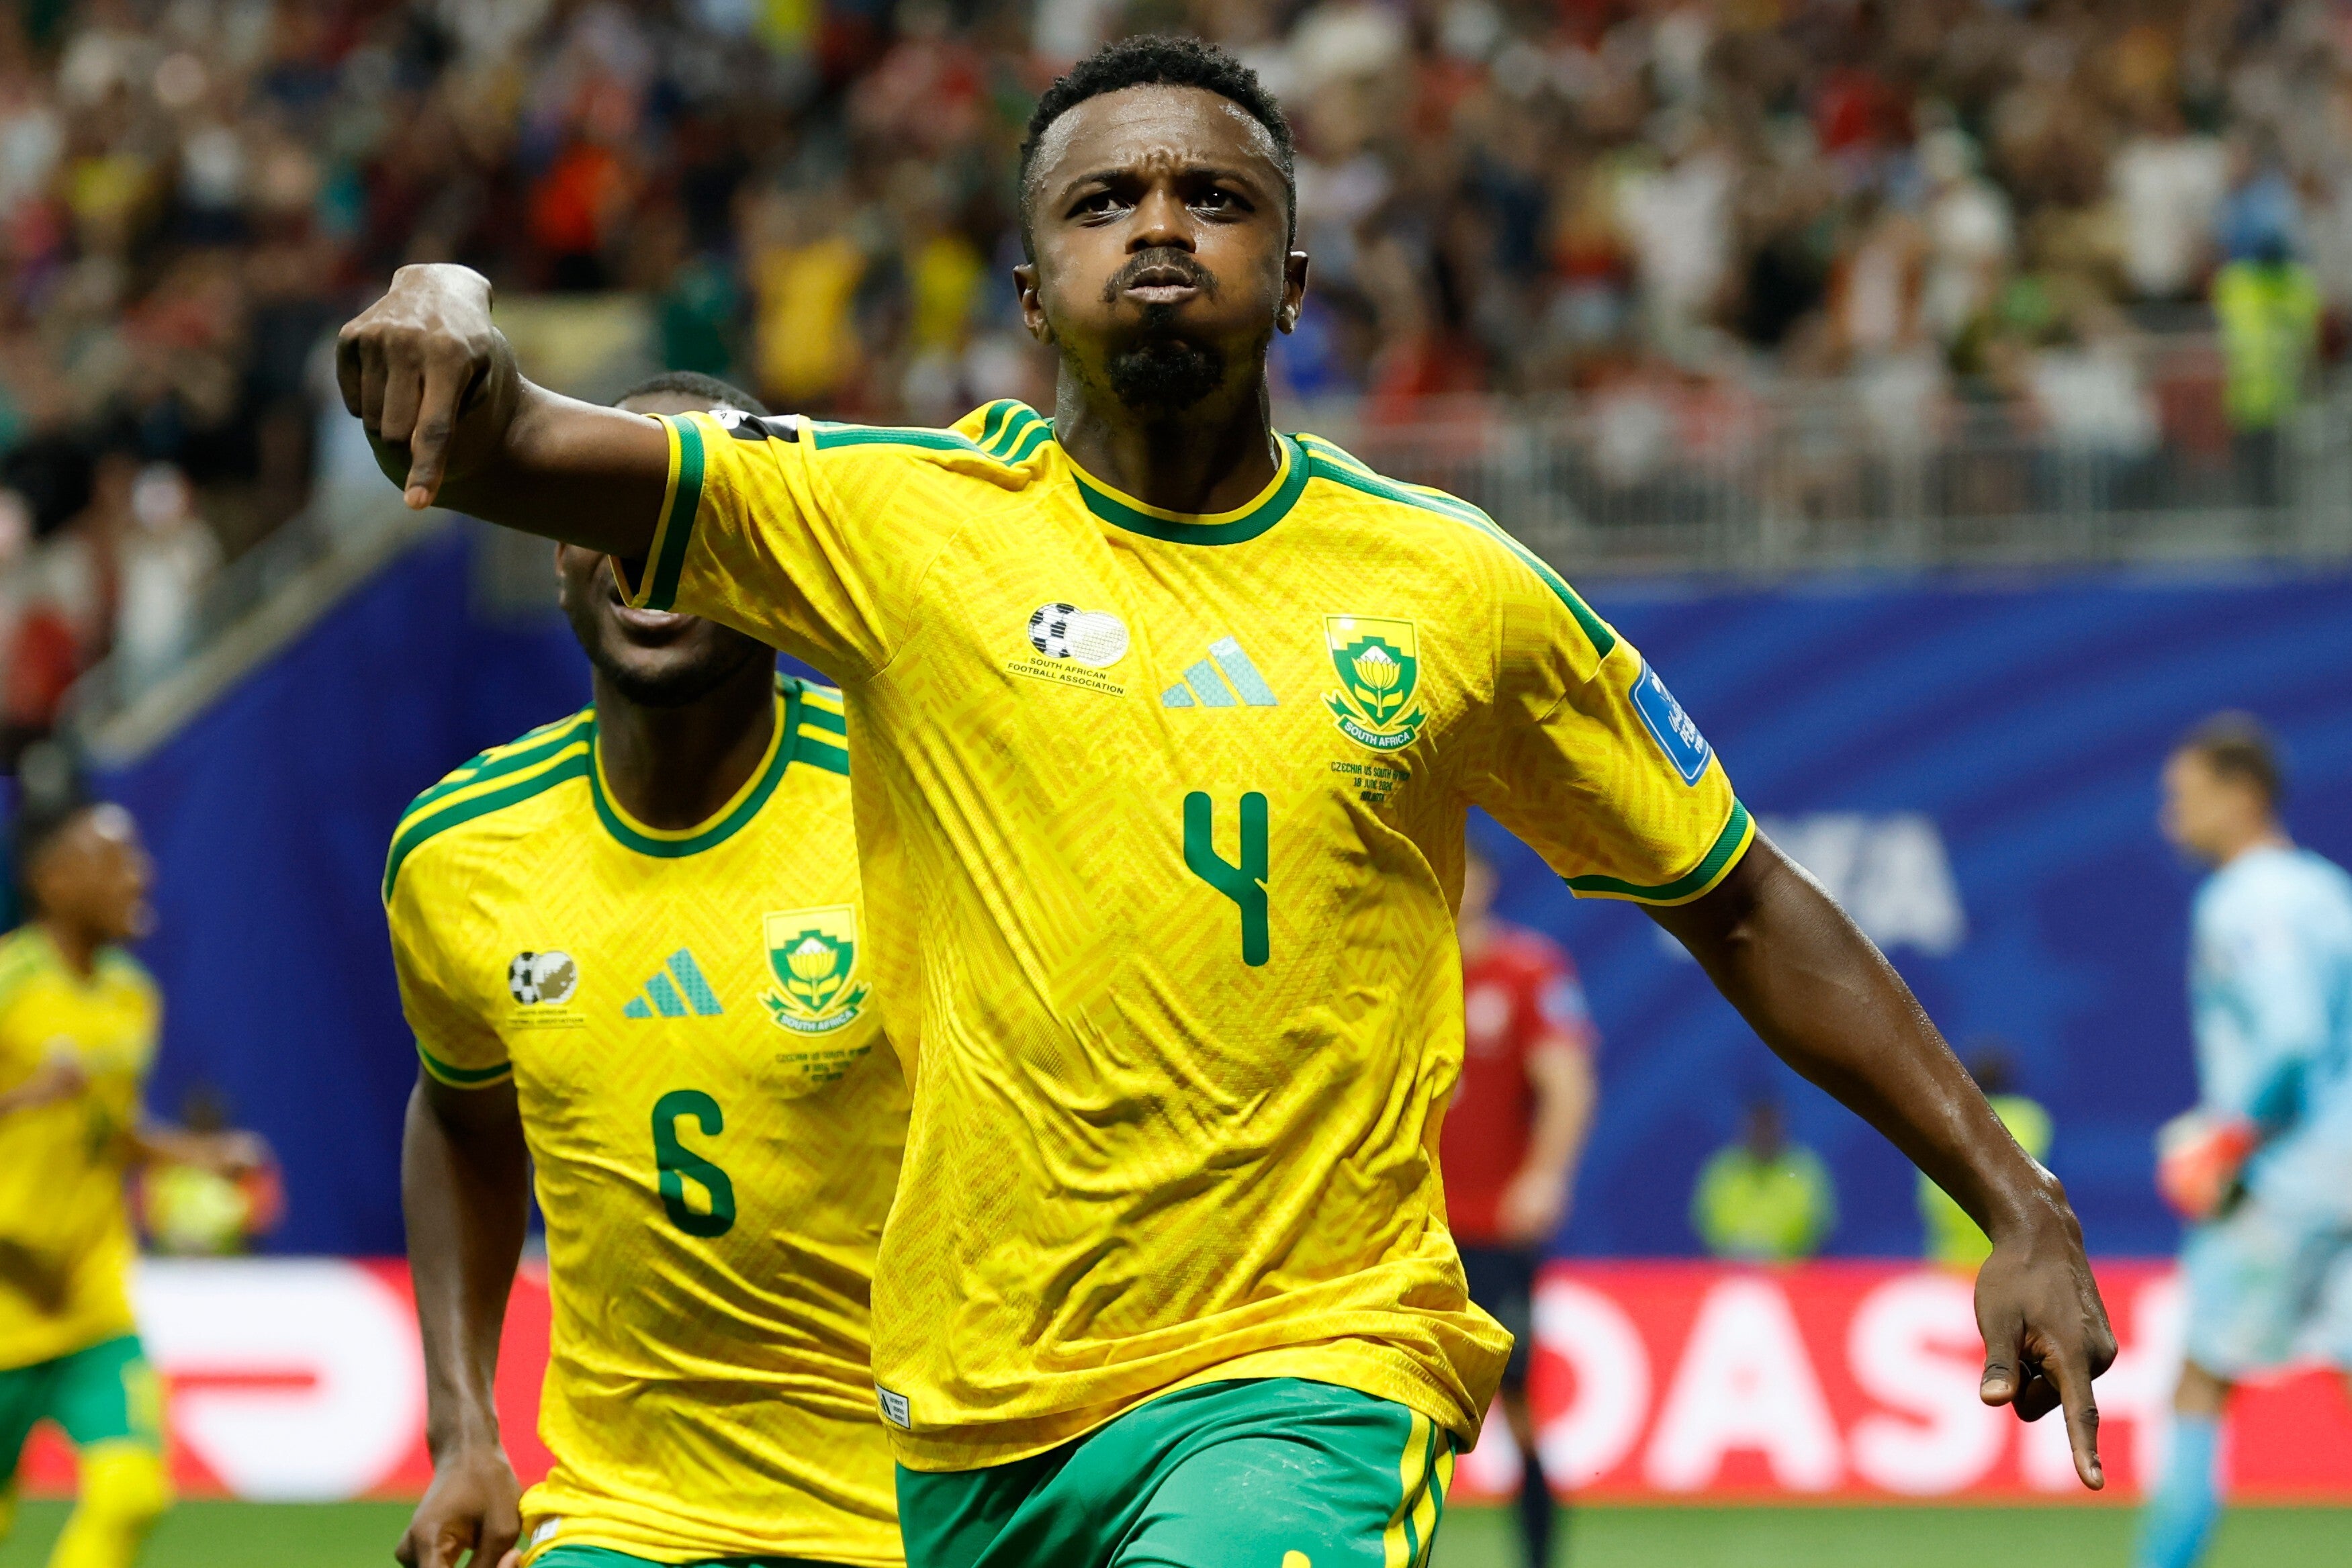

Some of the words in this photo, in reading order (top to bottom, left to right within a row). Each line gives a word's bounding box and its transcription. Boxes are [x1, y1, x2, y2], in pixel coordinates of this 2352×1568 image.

[1007, 663, 1056, 679] FOOTBALL
[1059, 674, 1124, 694] ASSOCIATION
[1030, 657, 1062, 670] SOUTH
[1065, 665, 1107, 680] AFRICAN
[1344, 721, 1377, 745] SOUTH
[1378, 731, 1410, 747] AFRICA
[1183, 791, 1269, 967] 4
[780, 1014, 817, 1031] SOUTH
[817, 1010, 854, 1031] AFRICA
[651, 1090, 736, 1238] 6
